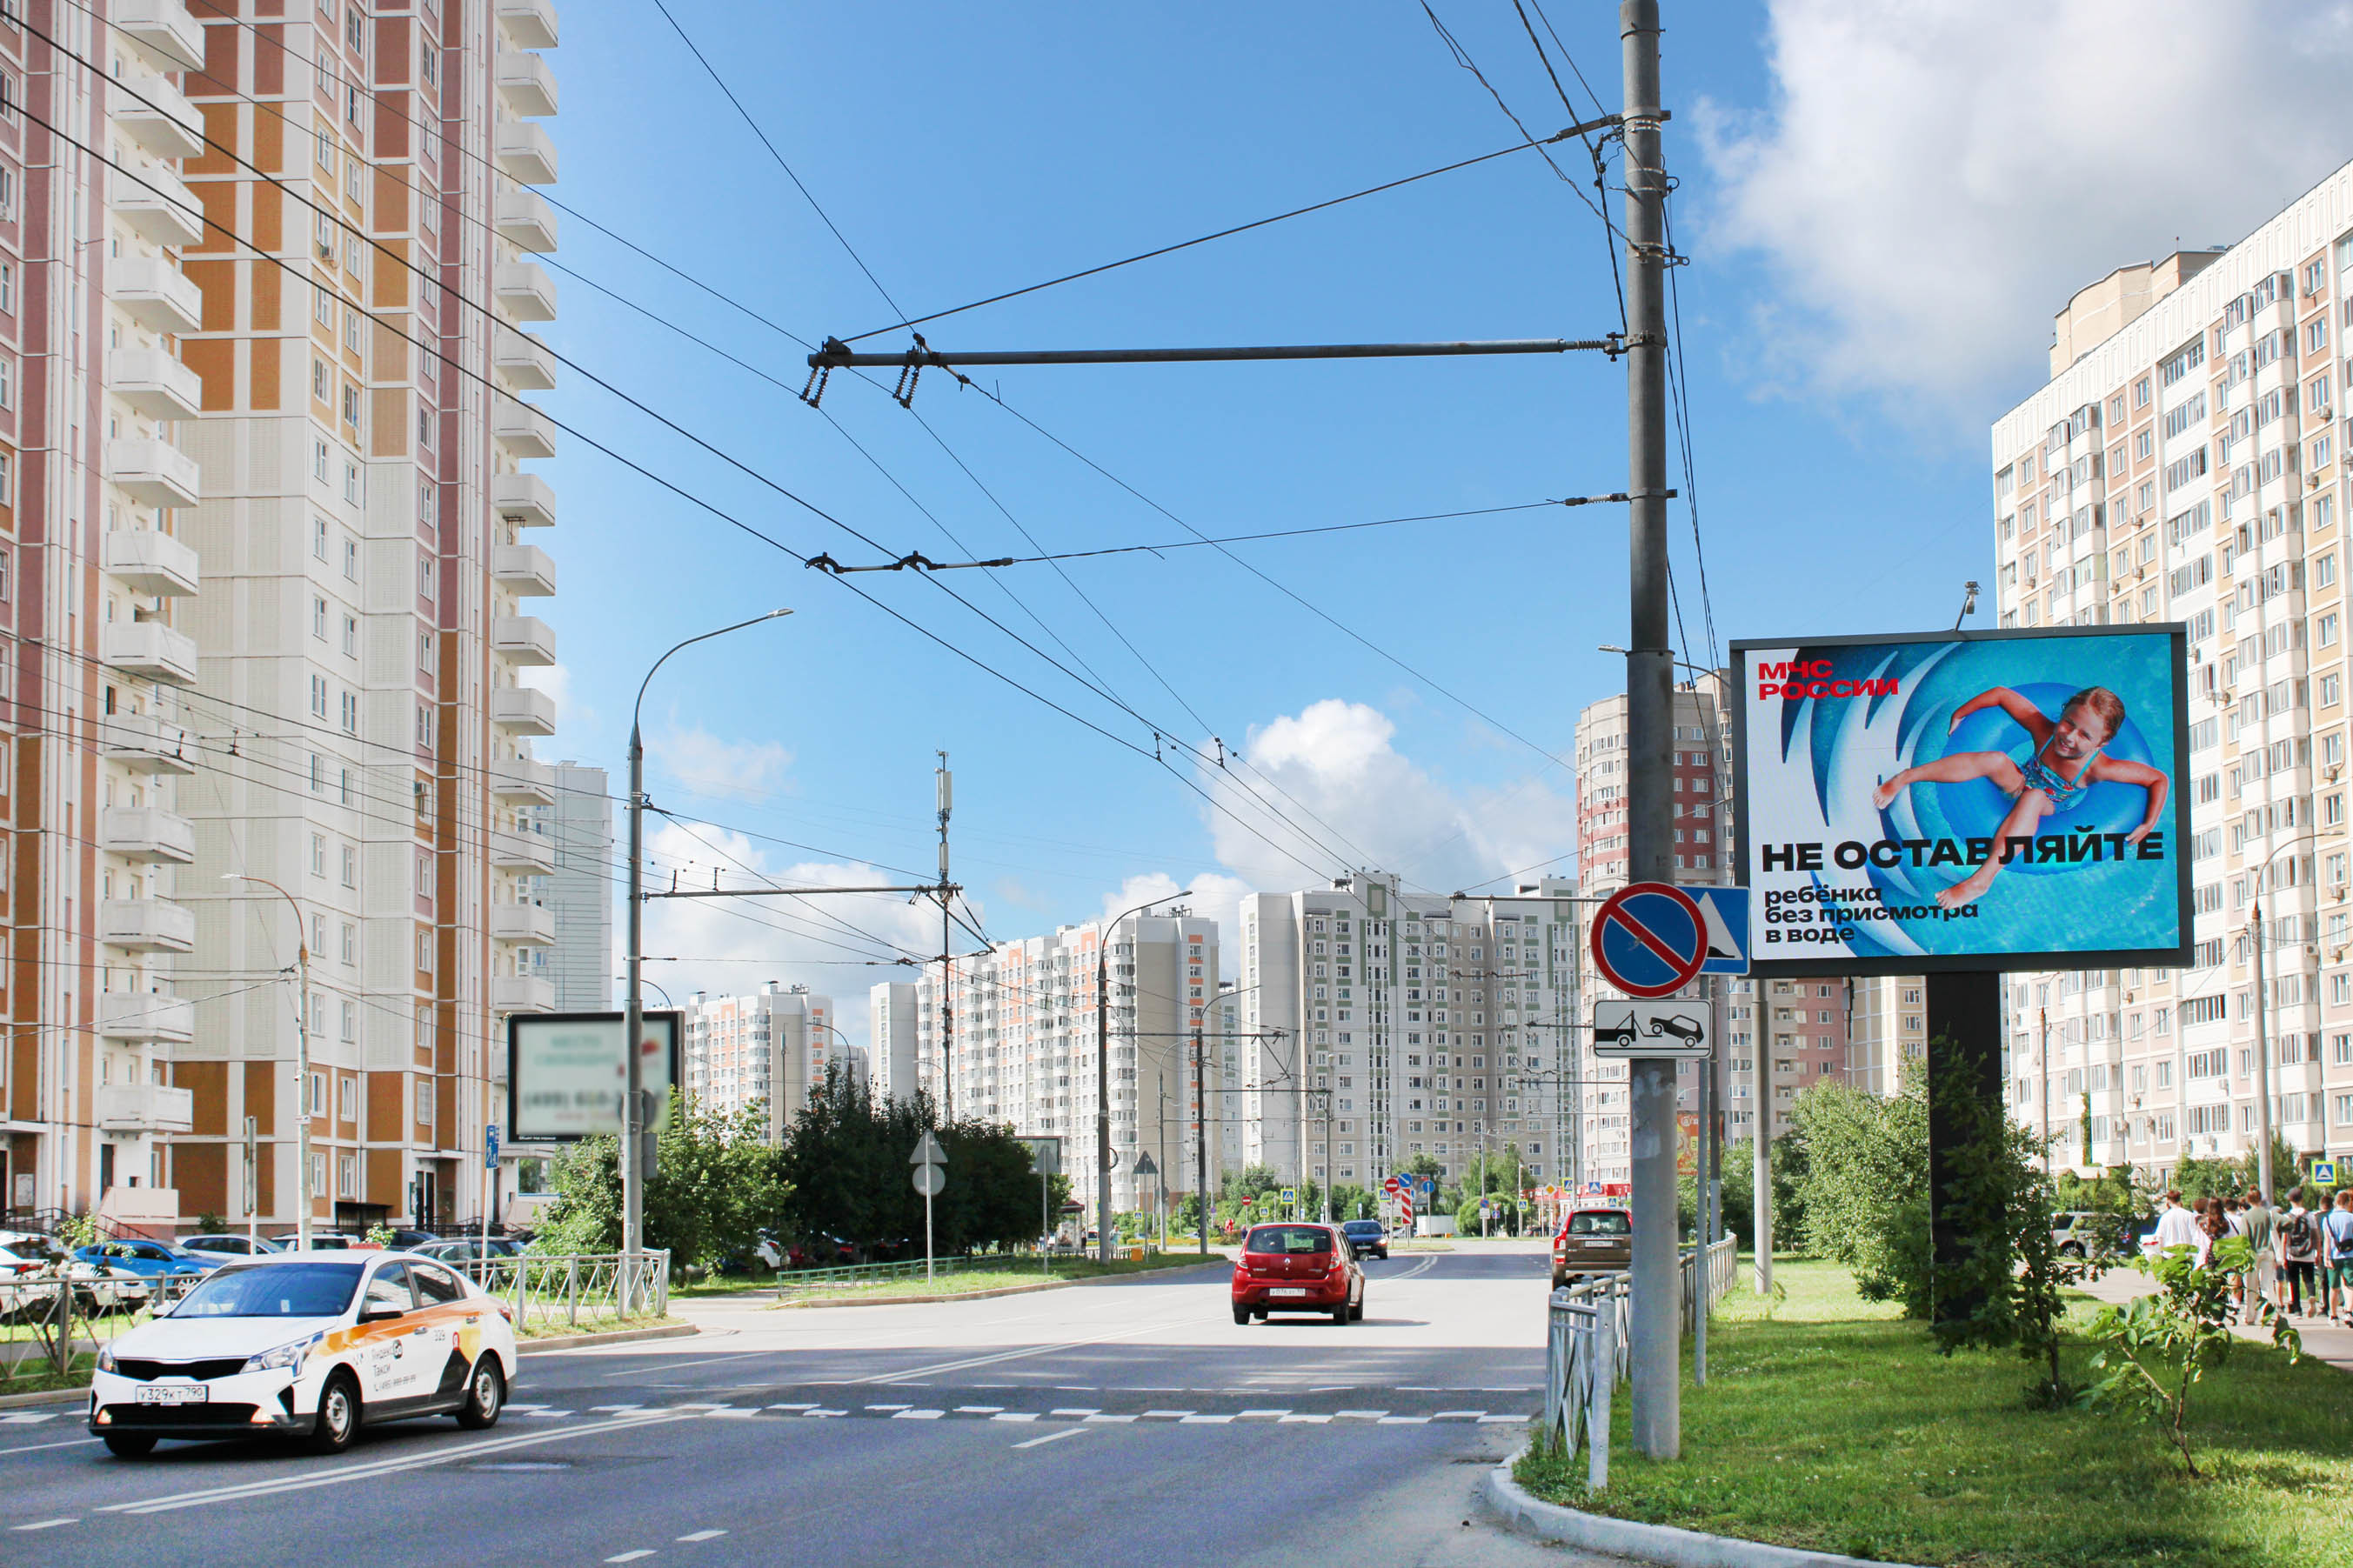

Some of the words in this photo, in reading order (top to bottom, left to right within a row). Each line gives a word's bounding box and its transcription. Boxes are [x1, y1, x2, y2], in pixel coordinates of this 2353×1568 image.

[1759, 659, 1833, 680] МЧС
[1759, 677, 1899, 700] РОССИИ
[1762, 843, 1823, 872] НЕ
[1834, 825, 2164, 870] ОСТАВЛЯЙТЕ
[1765, 884, 1882, 907] ребёнка
[1765, 906, 1813, 924] без
[1819, 904, 1978, 925] присмотра
[1766, 929, 1781, 943] в
[1787, 926, 1855, 944] воде
